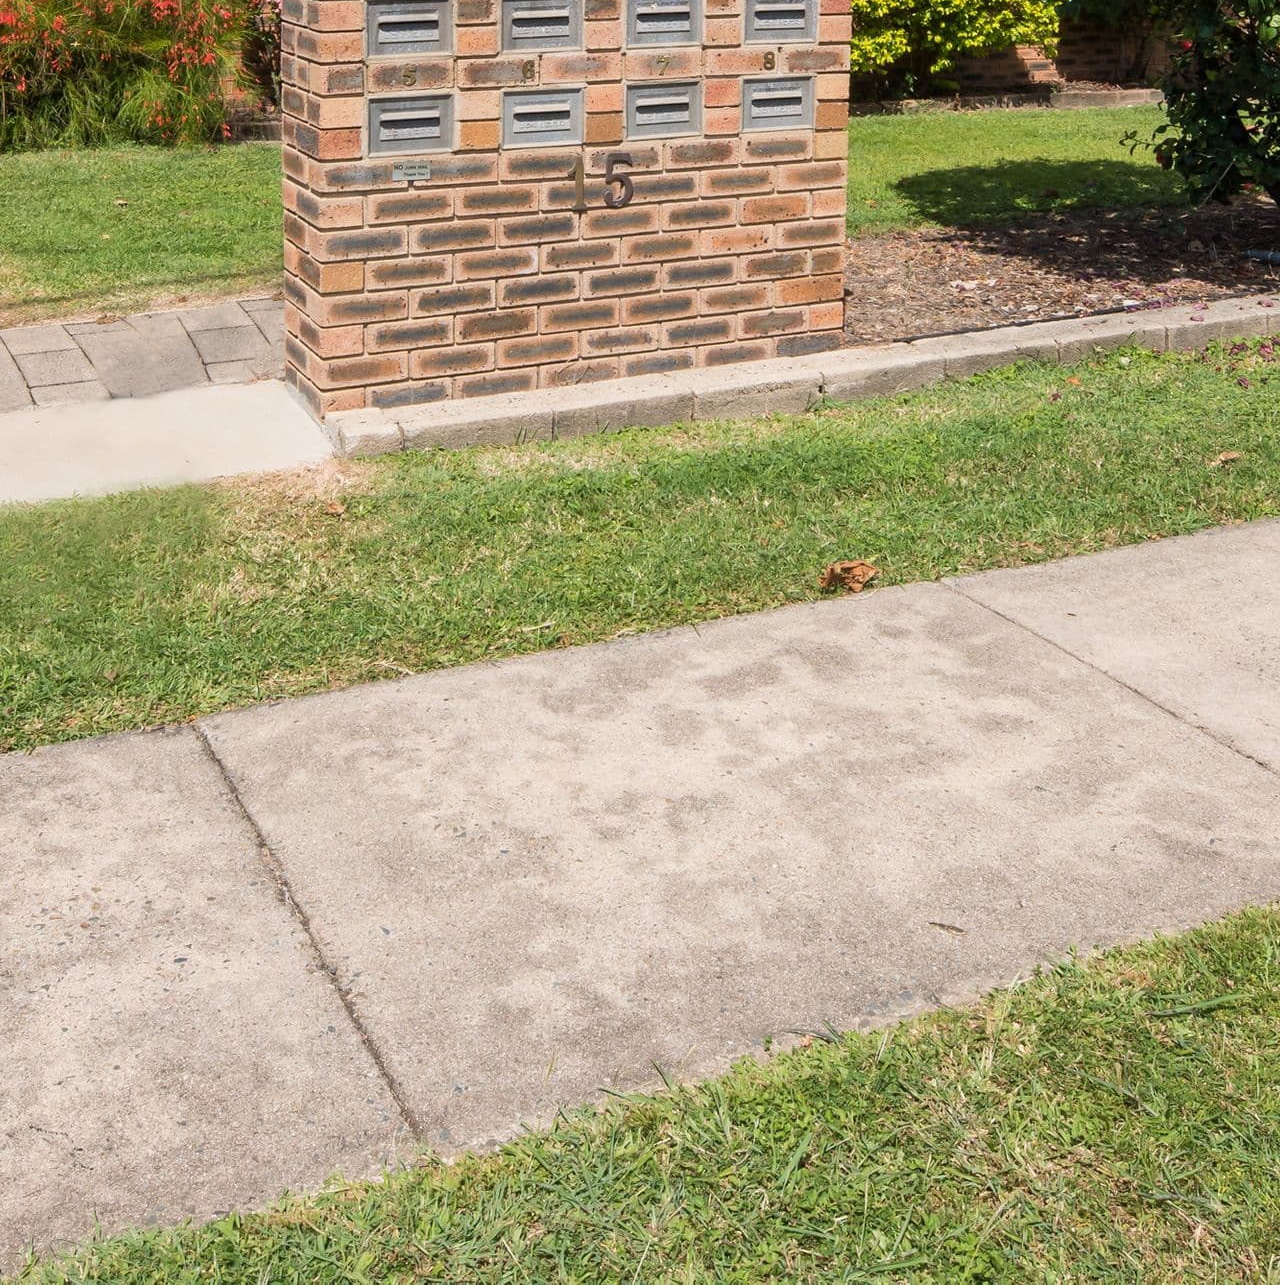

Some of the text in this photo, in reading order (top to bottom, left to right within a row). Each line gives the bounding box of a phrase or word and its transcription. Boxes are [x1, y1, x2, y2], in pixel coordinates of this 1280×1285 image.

[521, 59, 535, 80] 6
[657, 56, 669, 76] 7
[763, 51, 776, 71] 8
[402, 66, 417, 86] 5
[566, 152, 635, 211] 15
